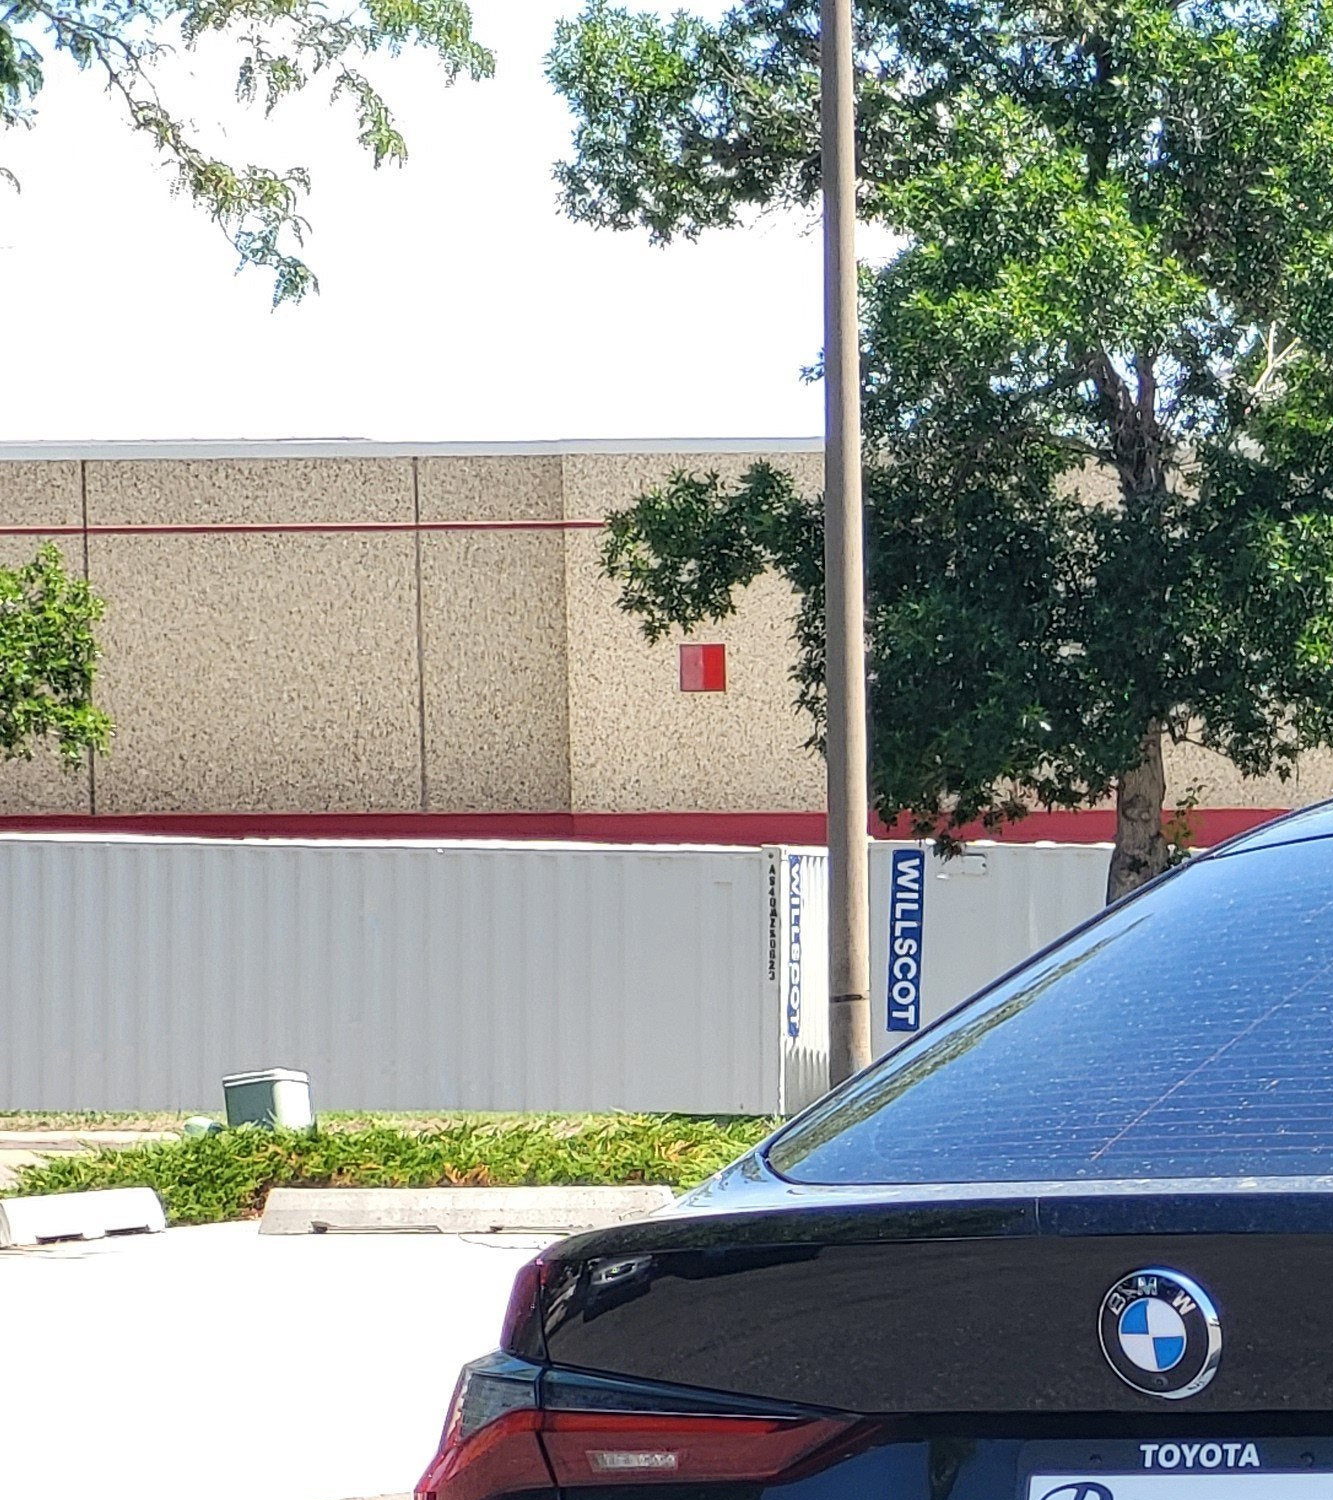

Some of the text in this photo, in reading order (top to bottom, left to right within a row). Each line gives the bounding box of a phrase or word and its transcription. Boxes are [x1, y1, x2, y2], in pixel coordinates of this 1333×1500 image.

[892, 857, 921, 1026] WILLSCOT
[1107, 1277, 1197, 1316] BMW
[1140, 1443, 1260, 1468] TOYOTA
